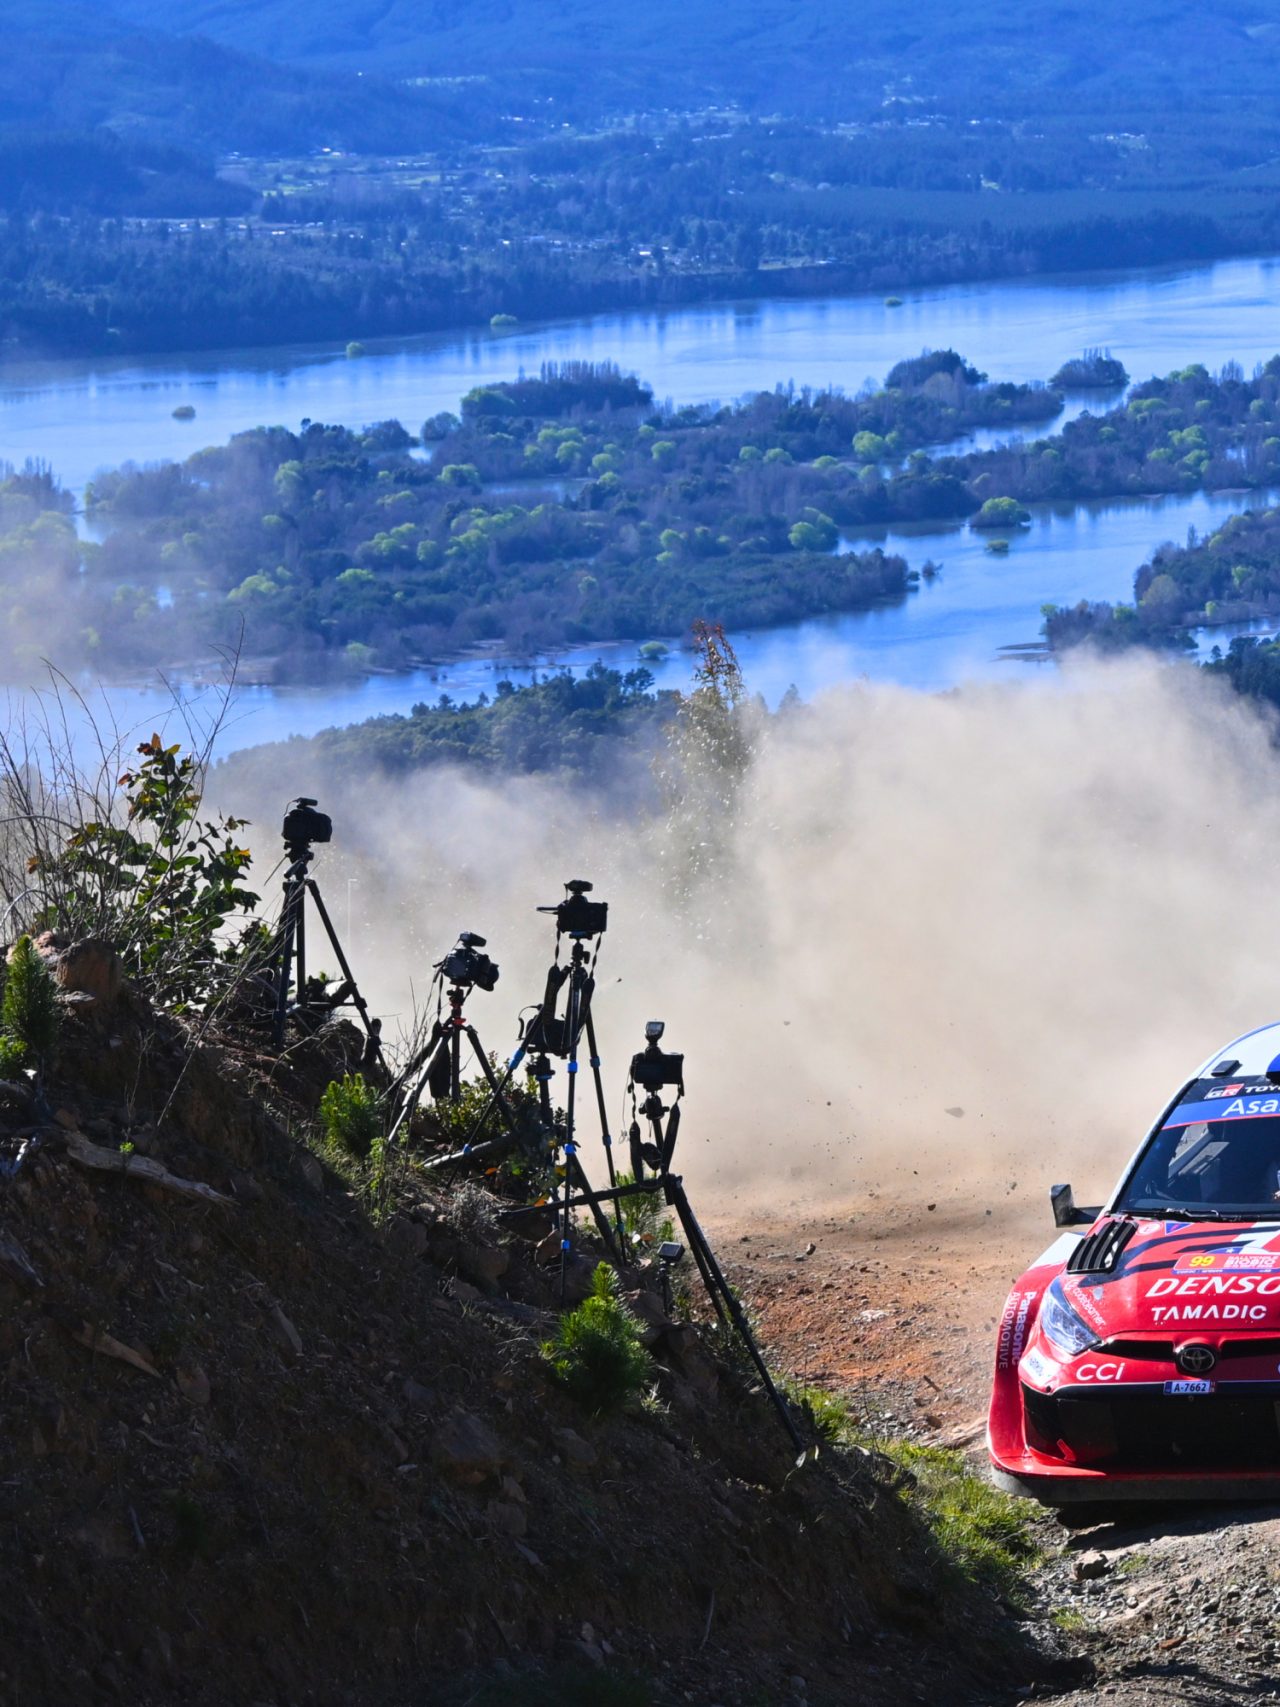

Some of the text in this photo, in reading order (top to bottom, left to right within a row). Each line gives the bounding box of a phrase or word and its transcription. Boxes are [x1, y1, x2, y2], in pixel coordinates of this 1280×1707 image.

[1189, 1256, 1215, 1267] 99
[1151, 1305, 1268, 1321] TAMADIC
[999, 1291, 1021, 1369] AUTOMOTIVE
[1012, 1291, 1037, 1365] Panasonic
[1174, 1383, 1206, 1392] A-7662
